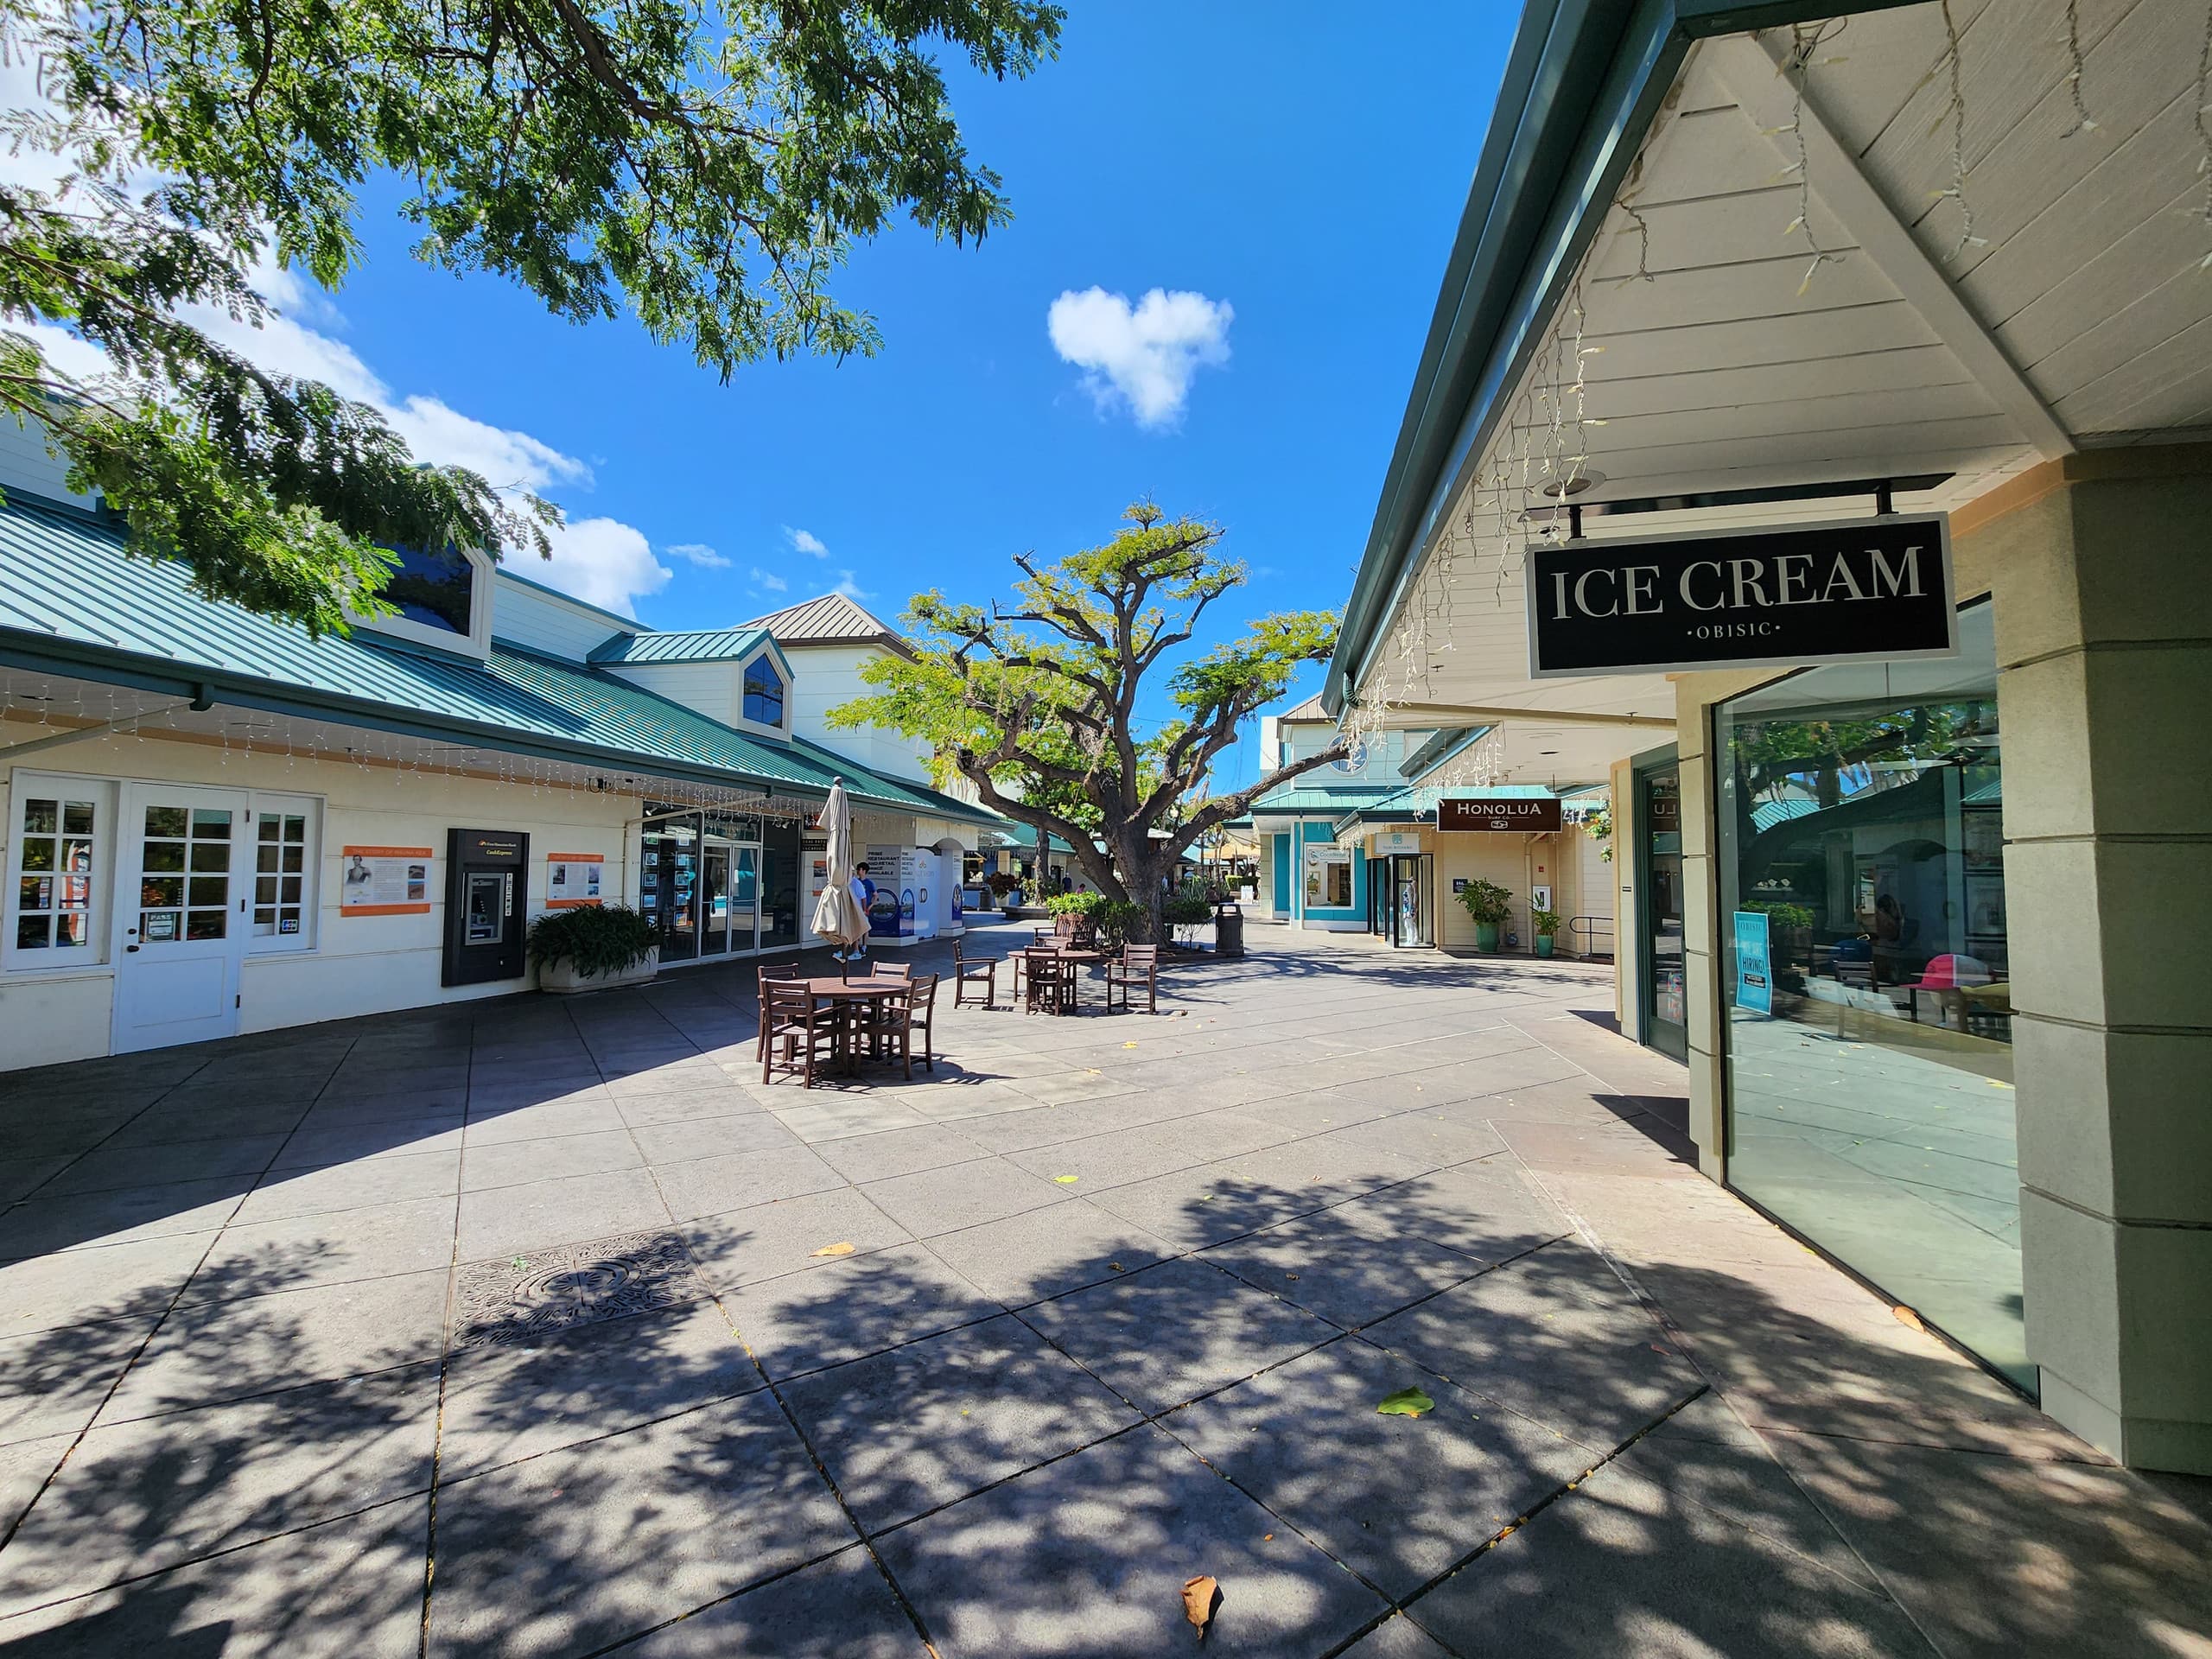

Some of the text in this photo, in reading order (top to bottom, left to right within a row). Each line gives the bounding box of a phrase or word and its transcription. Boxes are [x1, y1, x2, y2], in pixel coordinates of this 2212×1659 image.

[1550, 546, 1928, 620] ICE CREAM
[1457, 803, 1541, 815] HONOLUA
[1742, 957, 1765, 974] HIRING!
